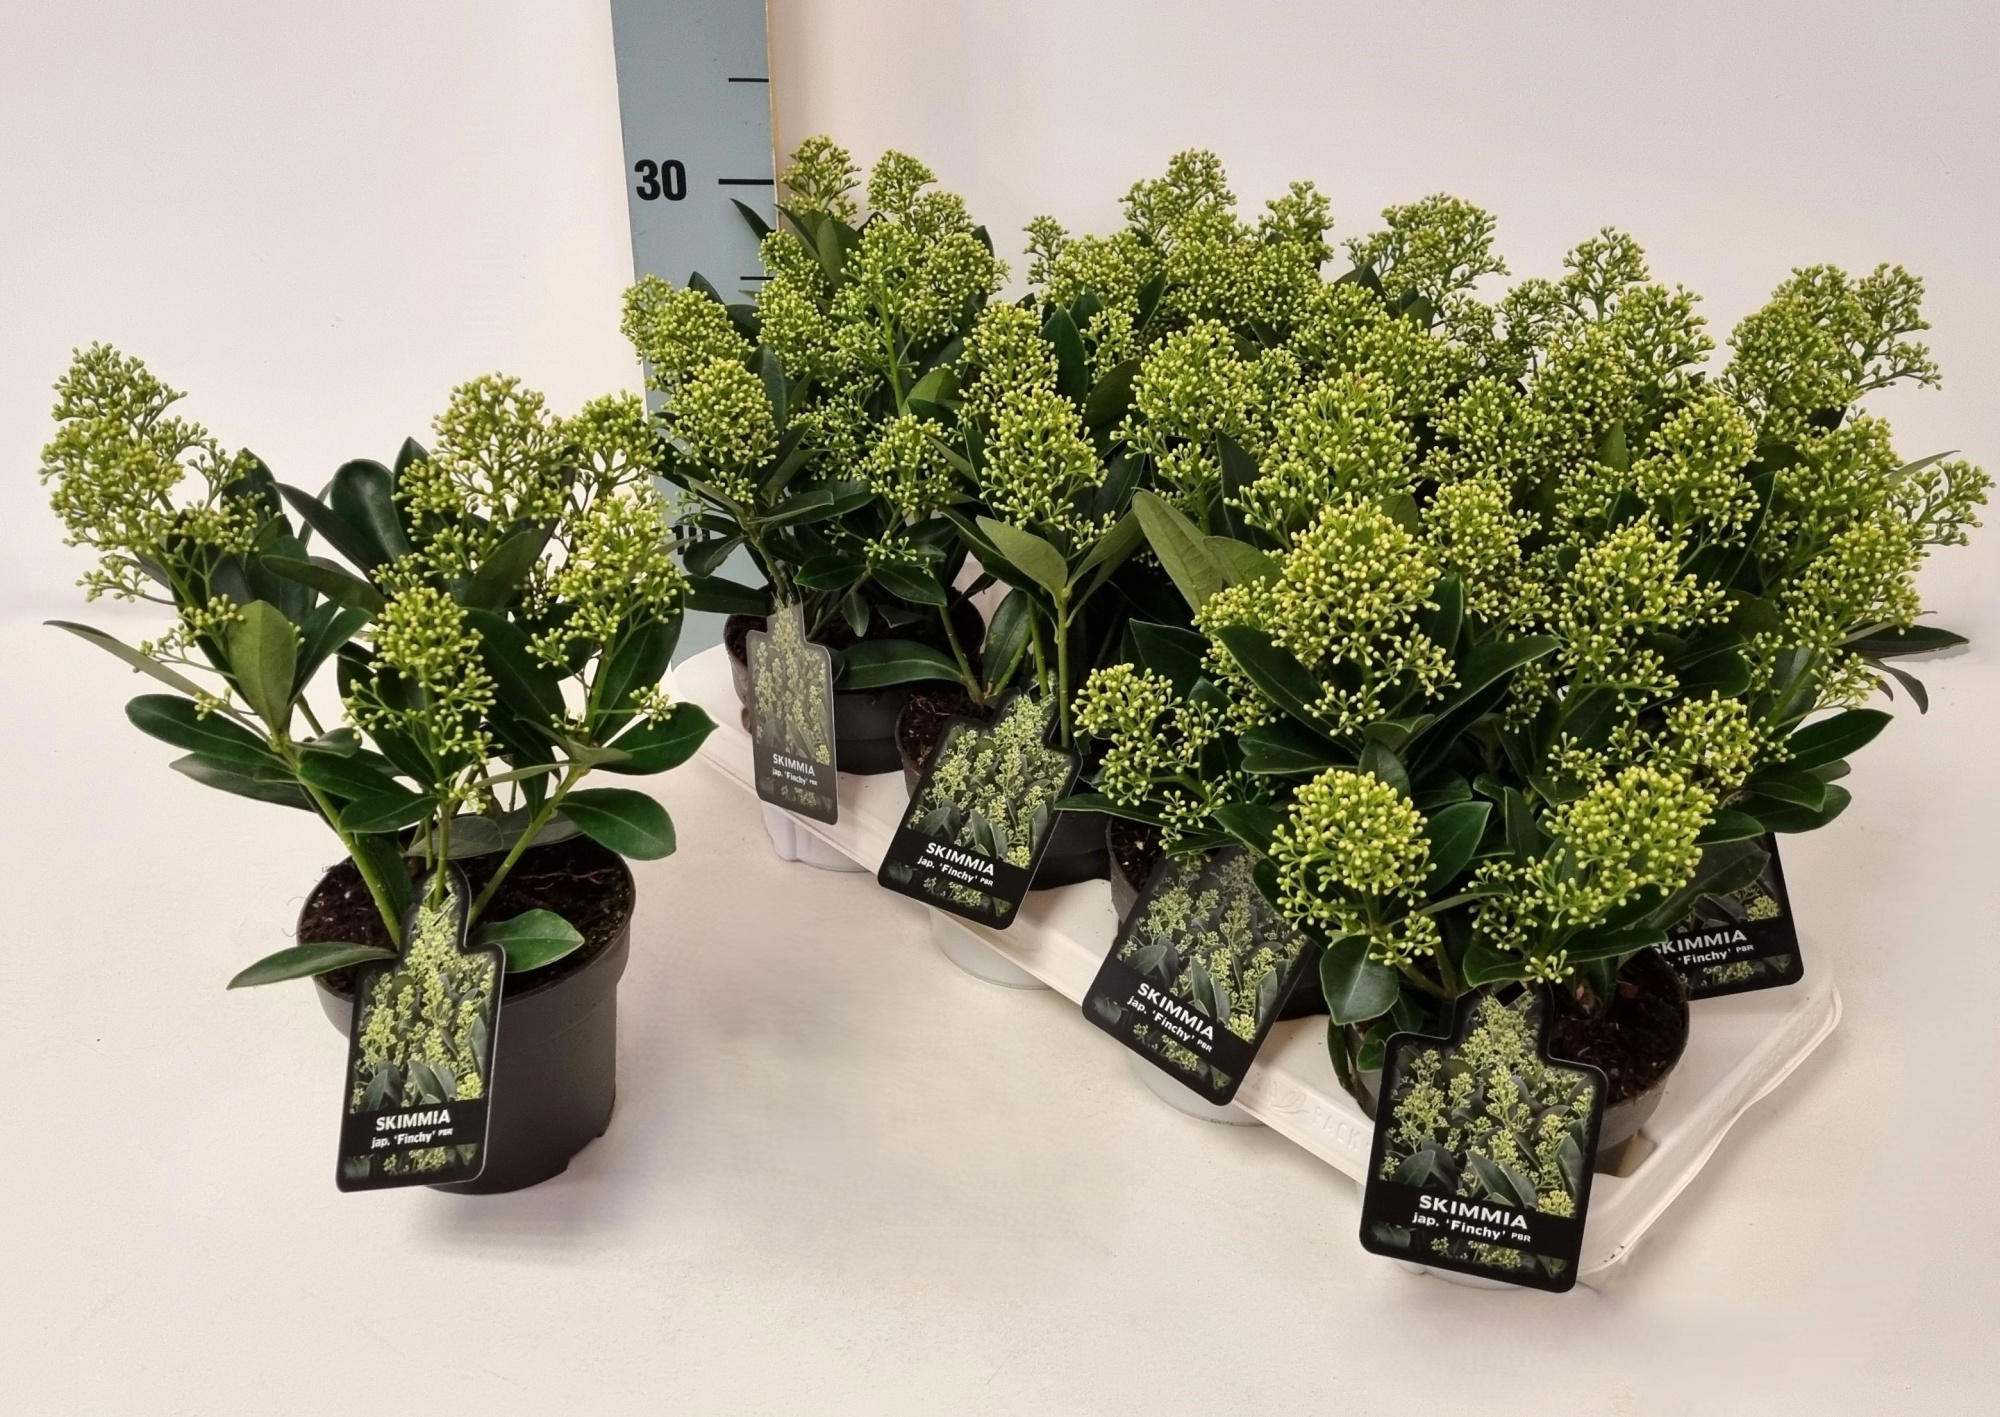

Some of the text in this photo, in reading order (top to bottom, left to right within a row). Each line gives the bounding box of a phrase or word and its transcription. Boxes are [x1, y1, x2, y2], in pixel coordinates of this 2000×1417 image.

[634, 159, 687, 201] 30
[772, 753, 816, 776] SKIMMIA
[916, 855, 935, 869] jap.
[979, 878, 994, 887] PBR
[925, 842, 995, 876] SKIMMIA
[1735, 944, 1754, 953] PBR
[1126, 995, 1147, 1014] jap.
[1196, 1038, 1213, 1053] PBR
[1136, 982, 1214, 1041] SKIMMIA
[375, 1109, 451, 1131] SKIMMIA
[370, 1136, 391, 1149] jap.
[1411, 1211, 1440, 1227] jap.
[1510, 1232, 1532, 1243] PBR
[1418, 1194, 1528, 1230] SKIMMIA
